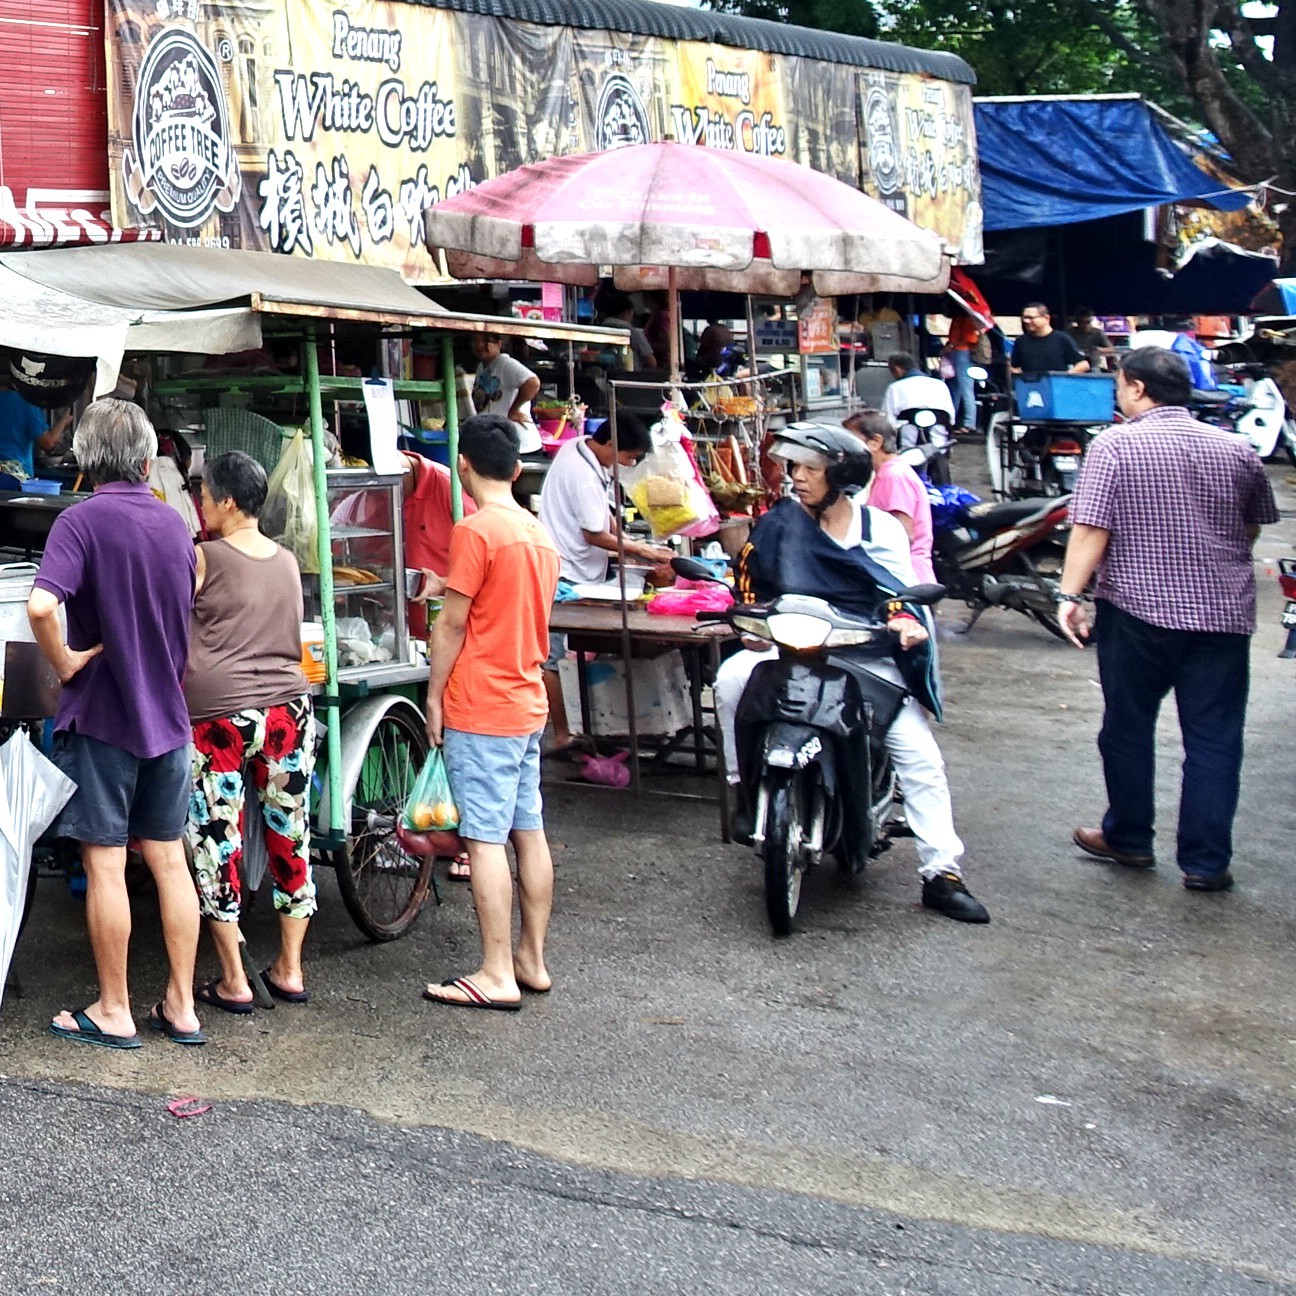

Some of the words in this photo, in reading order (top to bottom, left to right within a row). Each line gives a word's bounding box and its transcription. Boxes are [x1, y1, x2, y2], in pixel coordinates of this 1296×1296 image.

[333, 10, 401, 72] Penang
[274, 70, 373, 141] White
[376, 78, 456, 151] Coffee
[149, 124, 187, 170] COFFEE
[191, 126, 219, 171] TREE
[157, 171, 188, 203] PREMIUM
[187, 172, 211, 203] QUALITY
